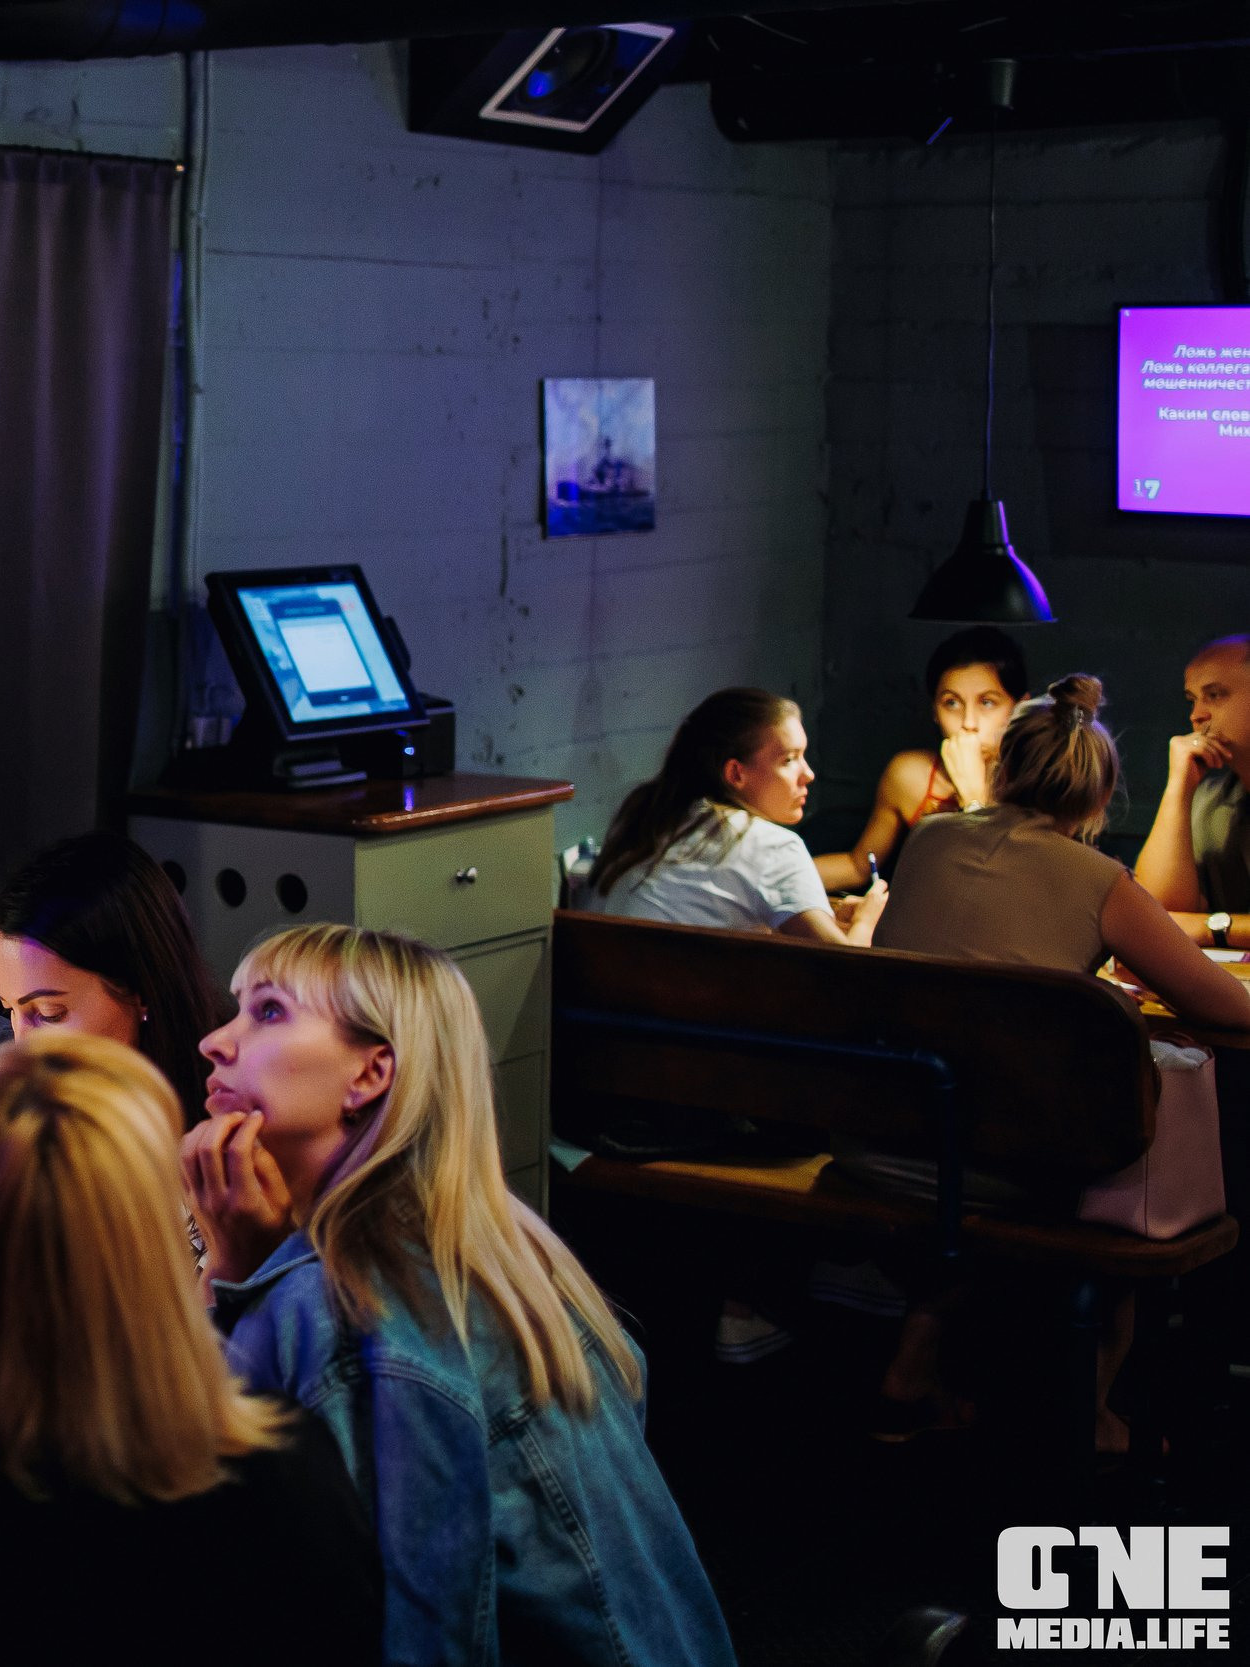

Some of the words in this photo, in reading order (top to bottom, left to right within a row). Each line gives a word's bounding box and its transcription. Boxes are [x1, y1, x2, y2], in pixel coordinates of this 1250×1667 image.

[1174, 344, 1217, 358] Ложь
[1141, 360, 1184, 374] Ложь
[1159, 407, 1208, 421] Каким
